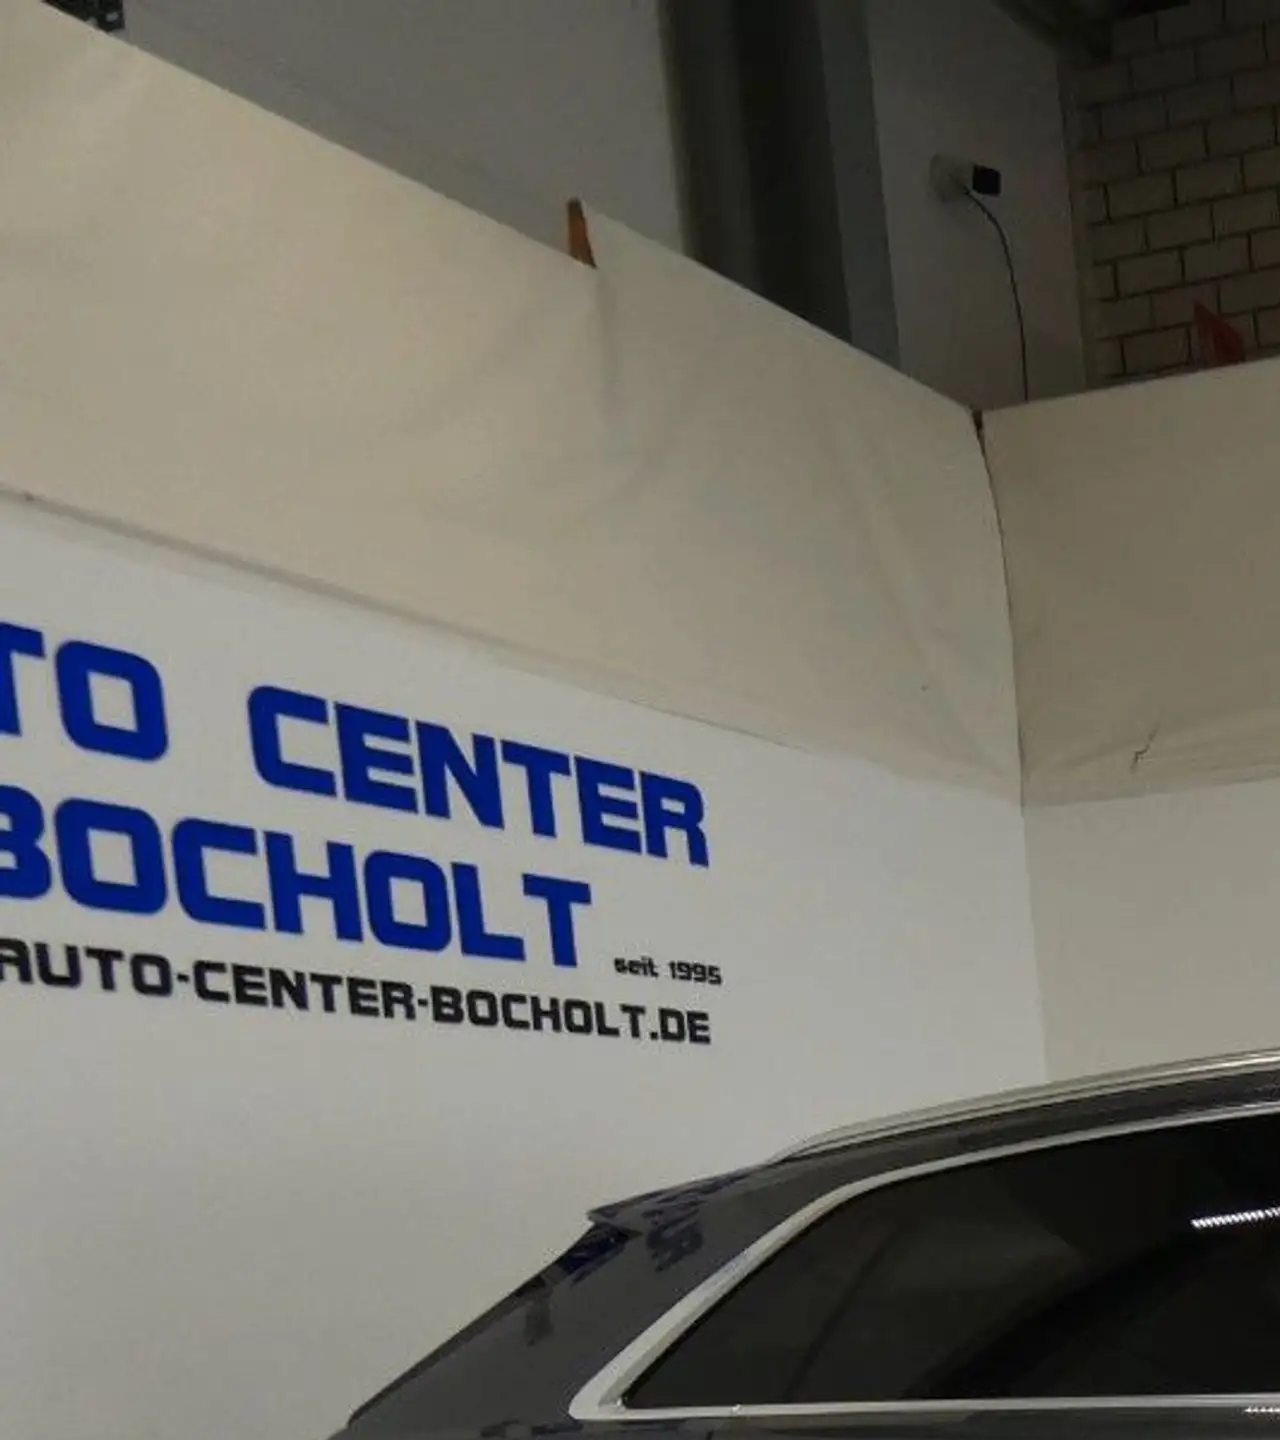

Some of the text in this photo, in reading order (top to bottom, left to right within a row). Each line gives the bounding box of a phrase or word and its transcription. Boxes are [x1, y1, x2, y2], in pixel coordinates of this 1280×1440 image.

[247, 685, 710, 868] CENTER
[613, 955, 723, 986] seit 1995
